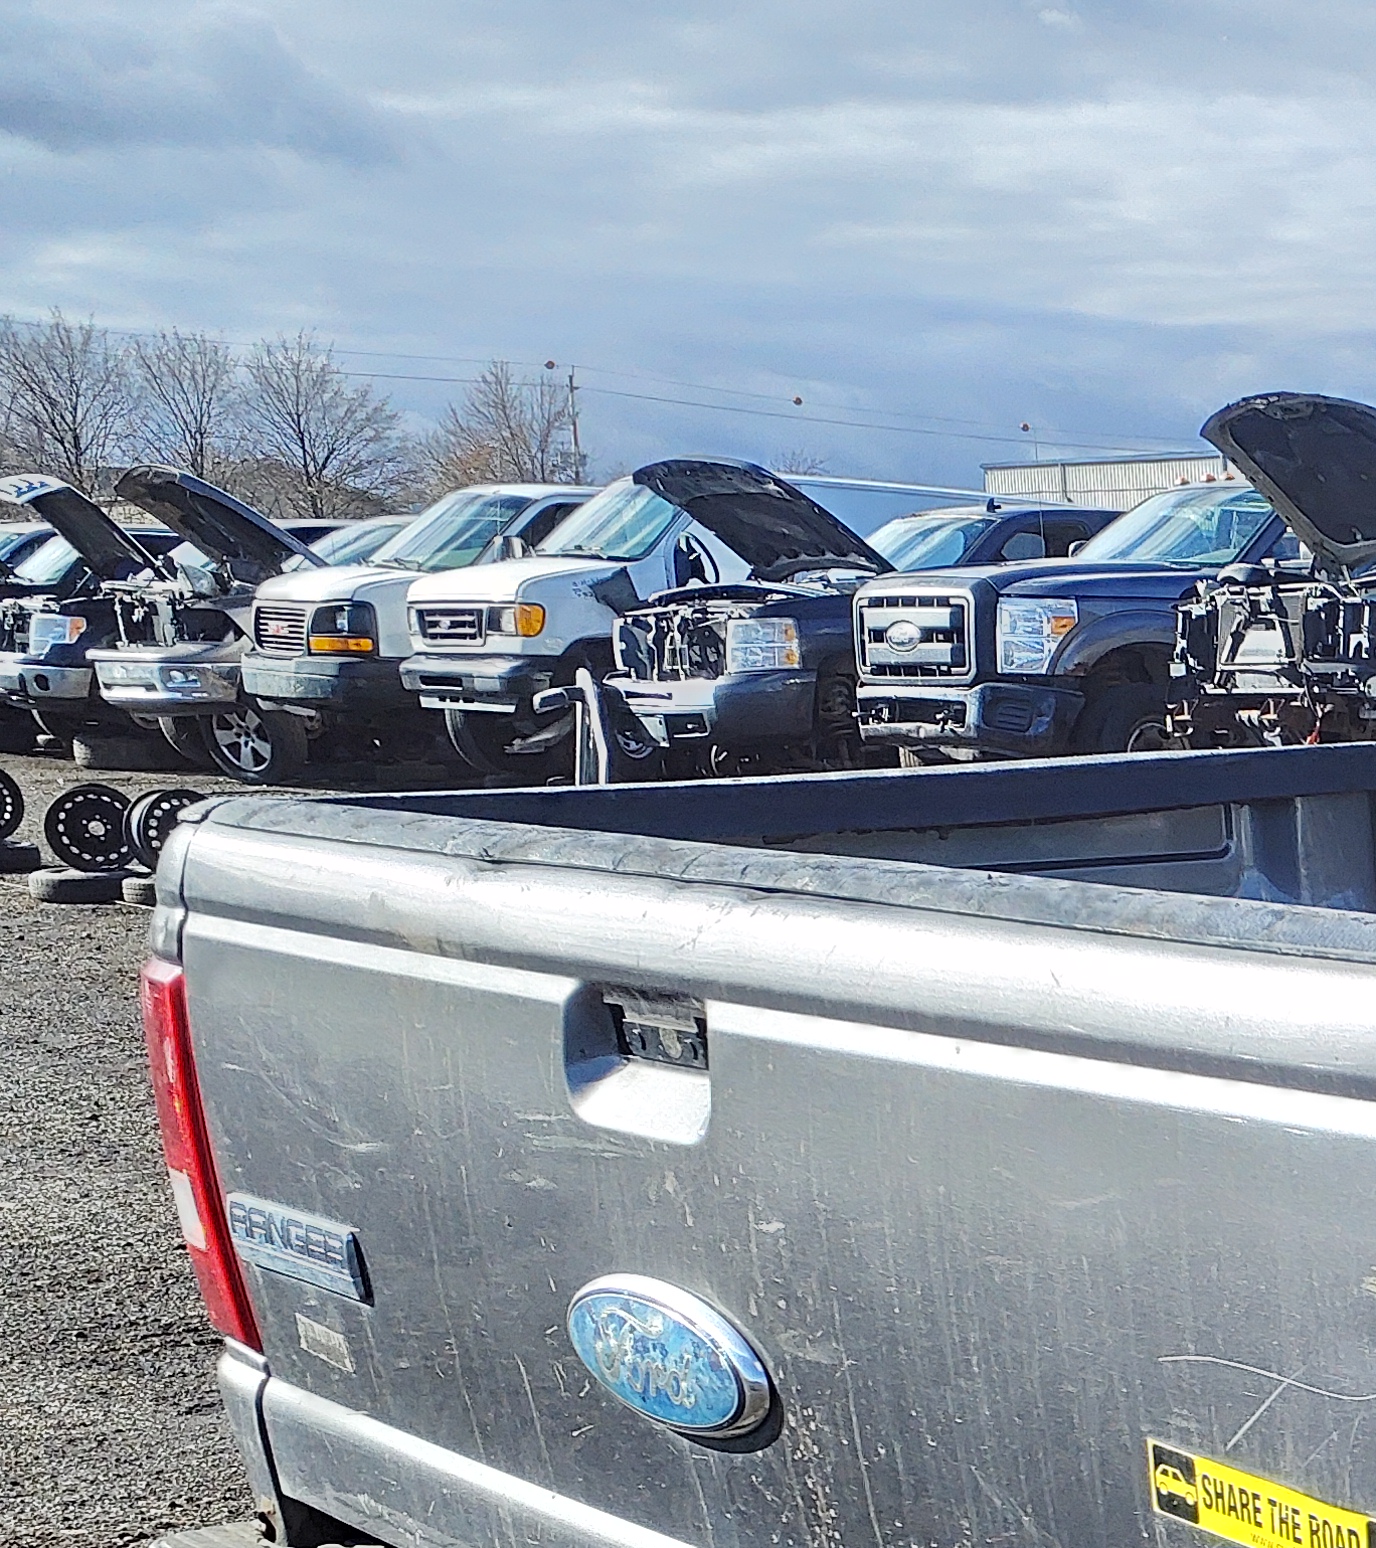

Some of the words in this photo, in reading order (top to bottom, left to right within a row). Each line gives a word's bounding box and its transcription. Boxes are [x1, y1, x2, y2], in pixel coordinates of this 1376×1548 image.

[229, 1200, 347, 1271] RANGER
[595, 1304, 698, 1410] Ford
[1201, 1473, 1263, 1528] SHARE
[1267, 1497, 1302, 1543] THE
